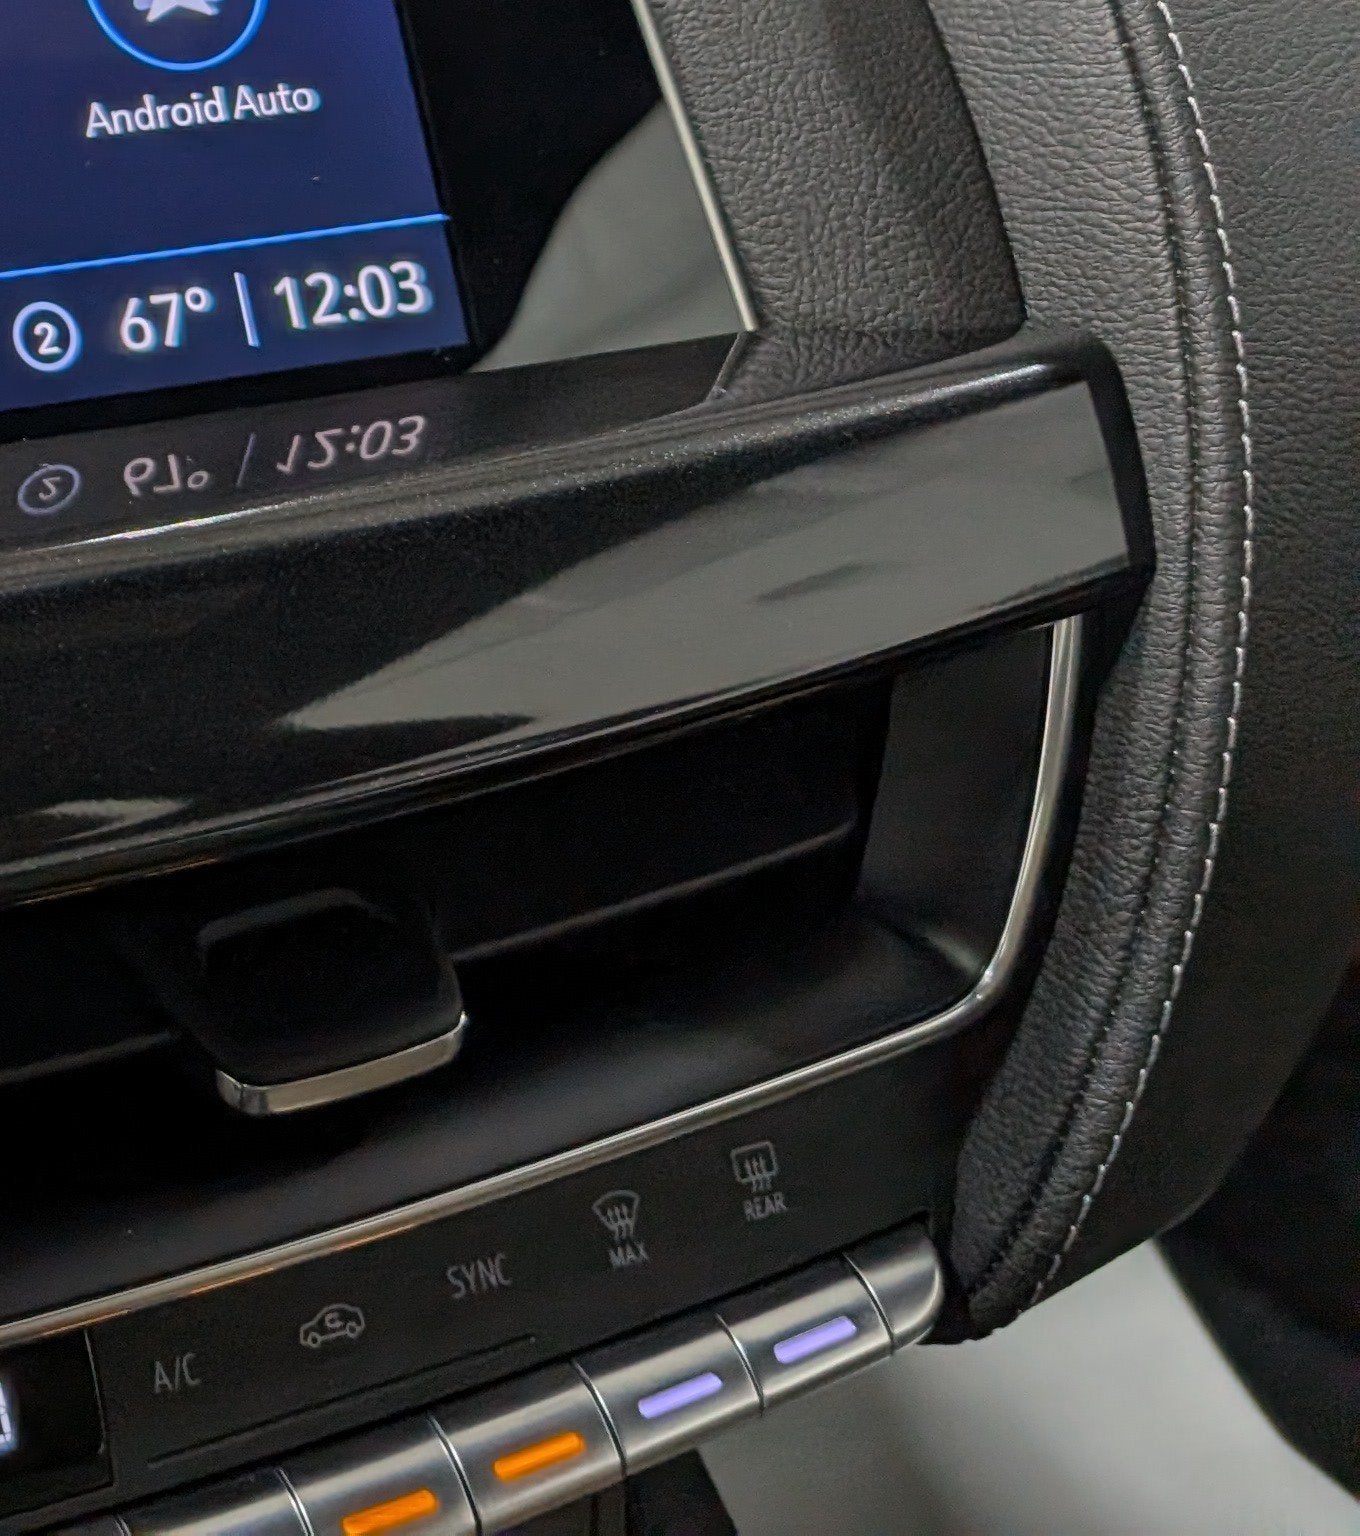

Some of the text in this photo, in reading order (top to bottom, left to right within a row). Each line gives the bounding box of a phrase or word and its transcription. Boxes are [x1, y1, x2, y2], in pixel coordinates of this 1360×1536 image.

[85, 83, 321, 138] Android Auto
[36, 323, 63, 355] 2
[274, 260, 434, 330] 12:03
[743, 1191, 789, 1221] REAR
[446, 1252, 514, 1300] SYNC
[608, 1241, 650, 1268] MAX
[153, 1353, 201, 1395] A/C
